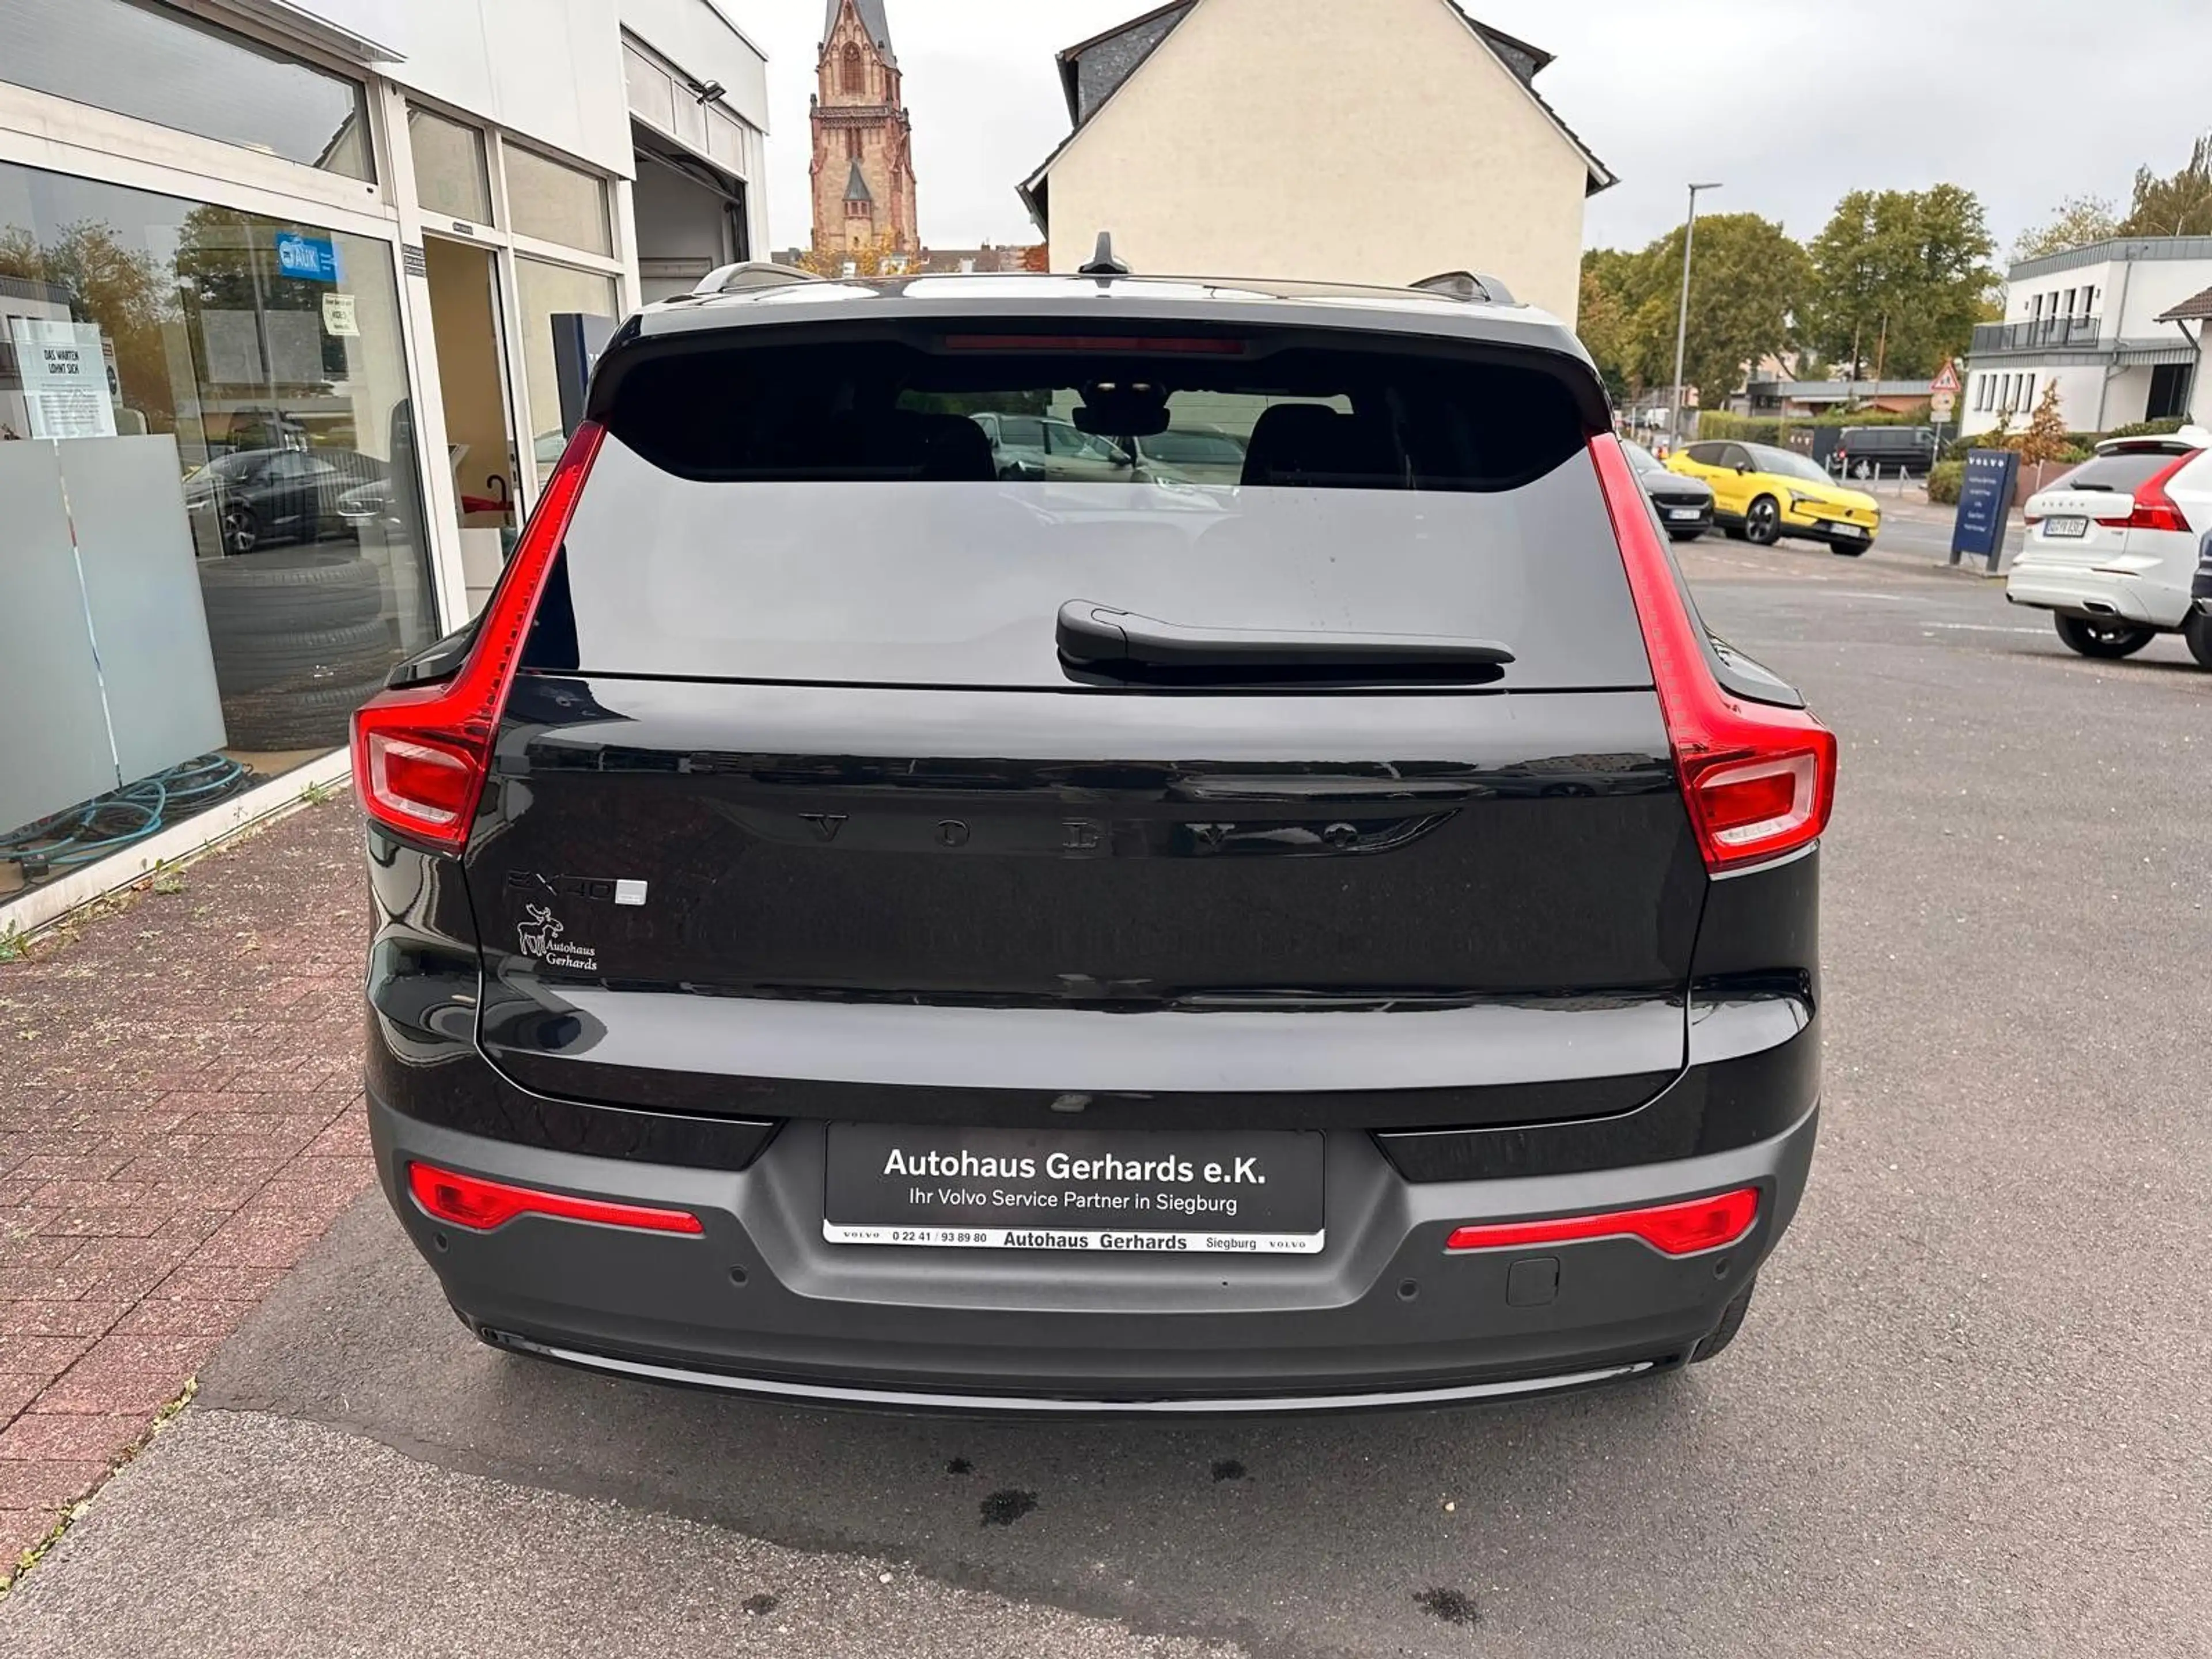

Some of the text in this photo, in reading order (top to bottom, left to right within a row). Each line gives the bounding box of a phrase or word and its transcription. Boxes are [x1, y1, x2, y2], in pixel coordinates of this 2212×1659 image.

[44, 350, 79, 361] DAS WARTEN
[48, 363, 79, 374] LOHNT SICH
[1969, 457, 2004, 467] VOLVO
[546, 939, 596, 956] Autohaus
[546, 953, 597, 971] Gerhards
[884, 1149, 1266, 1184] Autohaus Gerhards e.K.
[909, 1188, 1238, 1215] Ihr Volvo Service Partner in Siegburg
[893, 1232, 899, 1240] 0
[902, 1232, 915, 1241] 22
[918, 1232, 931, 1241] 41
[941, 1233, 954, 1242] 93
[957, 1233, 970, 1242] 89
[974, 1233, 987, 1243] 80
[1004, 1232, 1089, 1248] Autohaus
[1100, 1234, 1188, 1249] Gerhards
[1206, 1237, 1256, 1250] Siegburg
[1269, 1240, 1306, 1248] VOLVO
